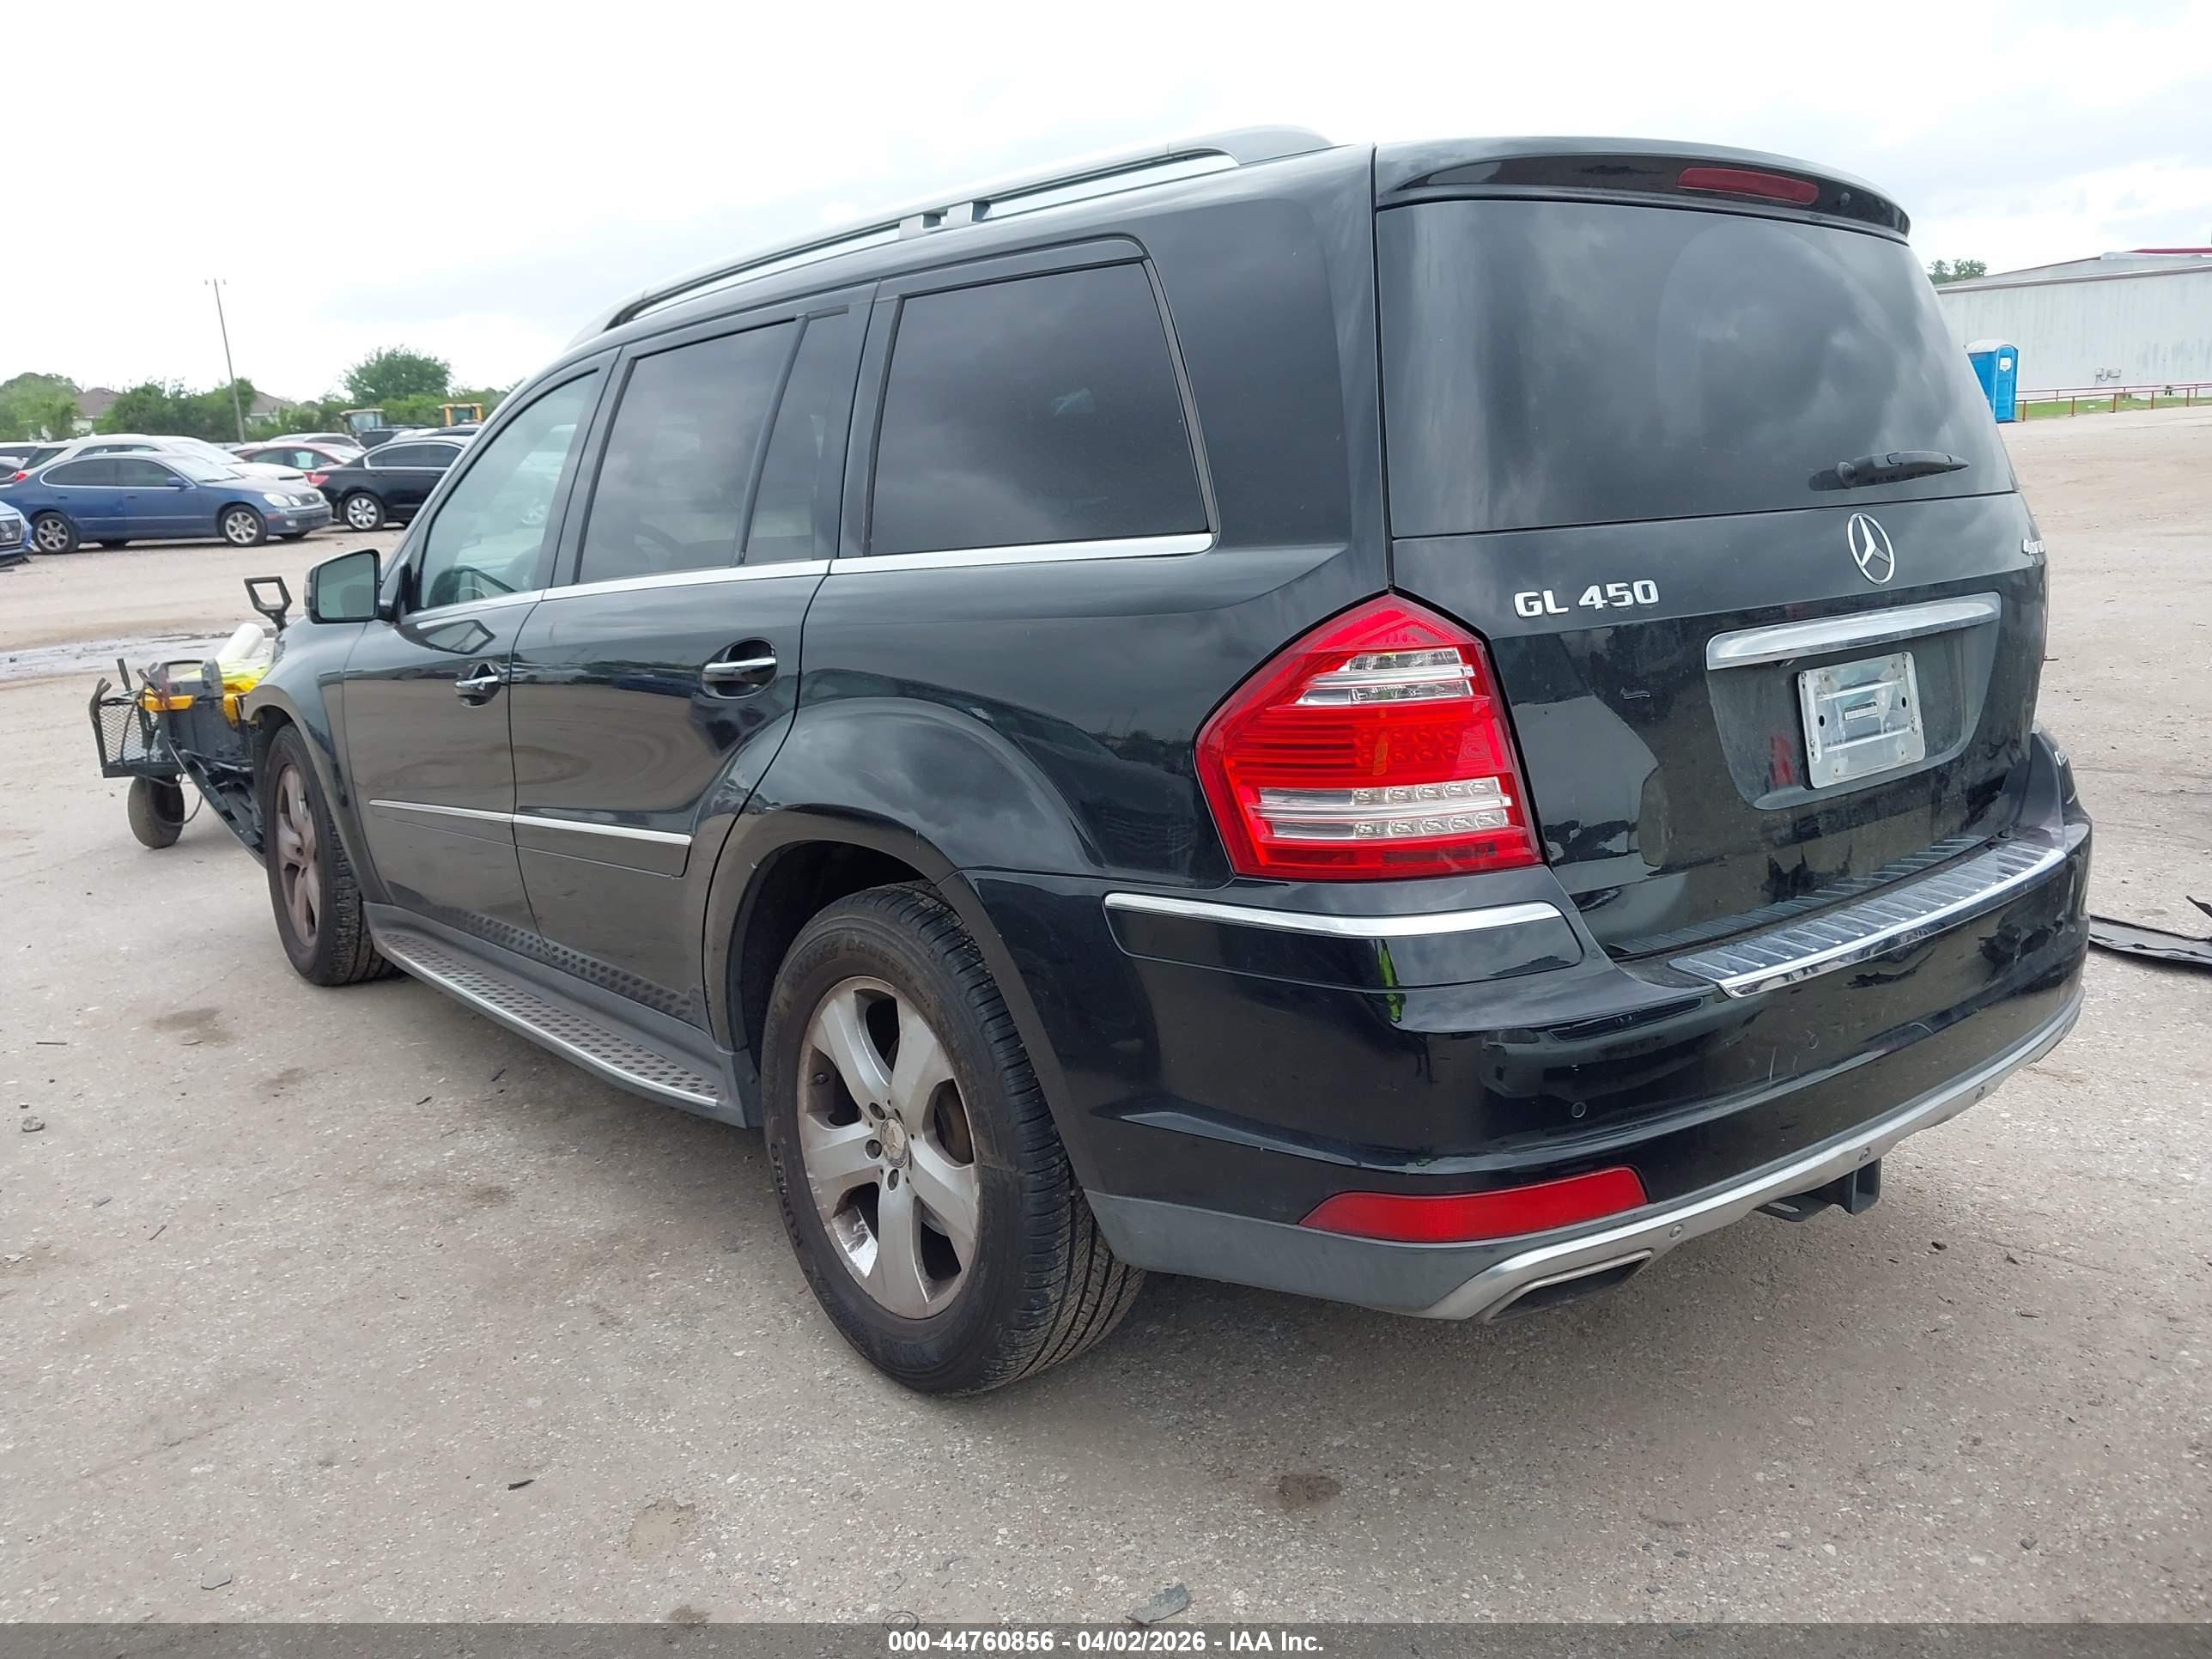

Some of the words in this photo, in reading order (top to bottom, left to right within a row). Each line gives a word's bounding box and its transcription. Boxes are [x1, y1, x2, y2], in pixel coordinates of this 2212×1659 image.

[1514, 590, 1570, 618] GL
[1578, 580, 1660, 611] 450
[770, 1142, 804, 1248] KUMHO
